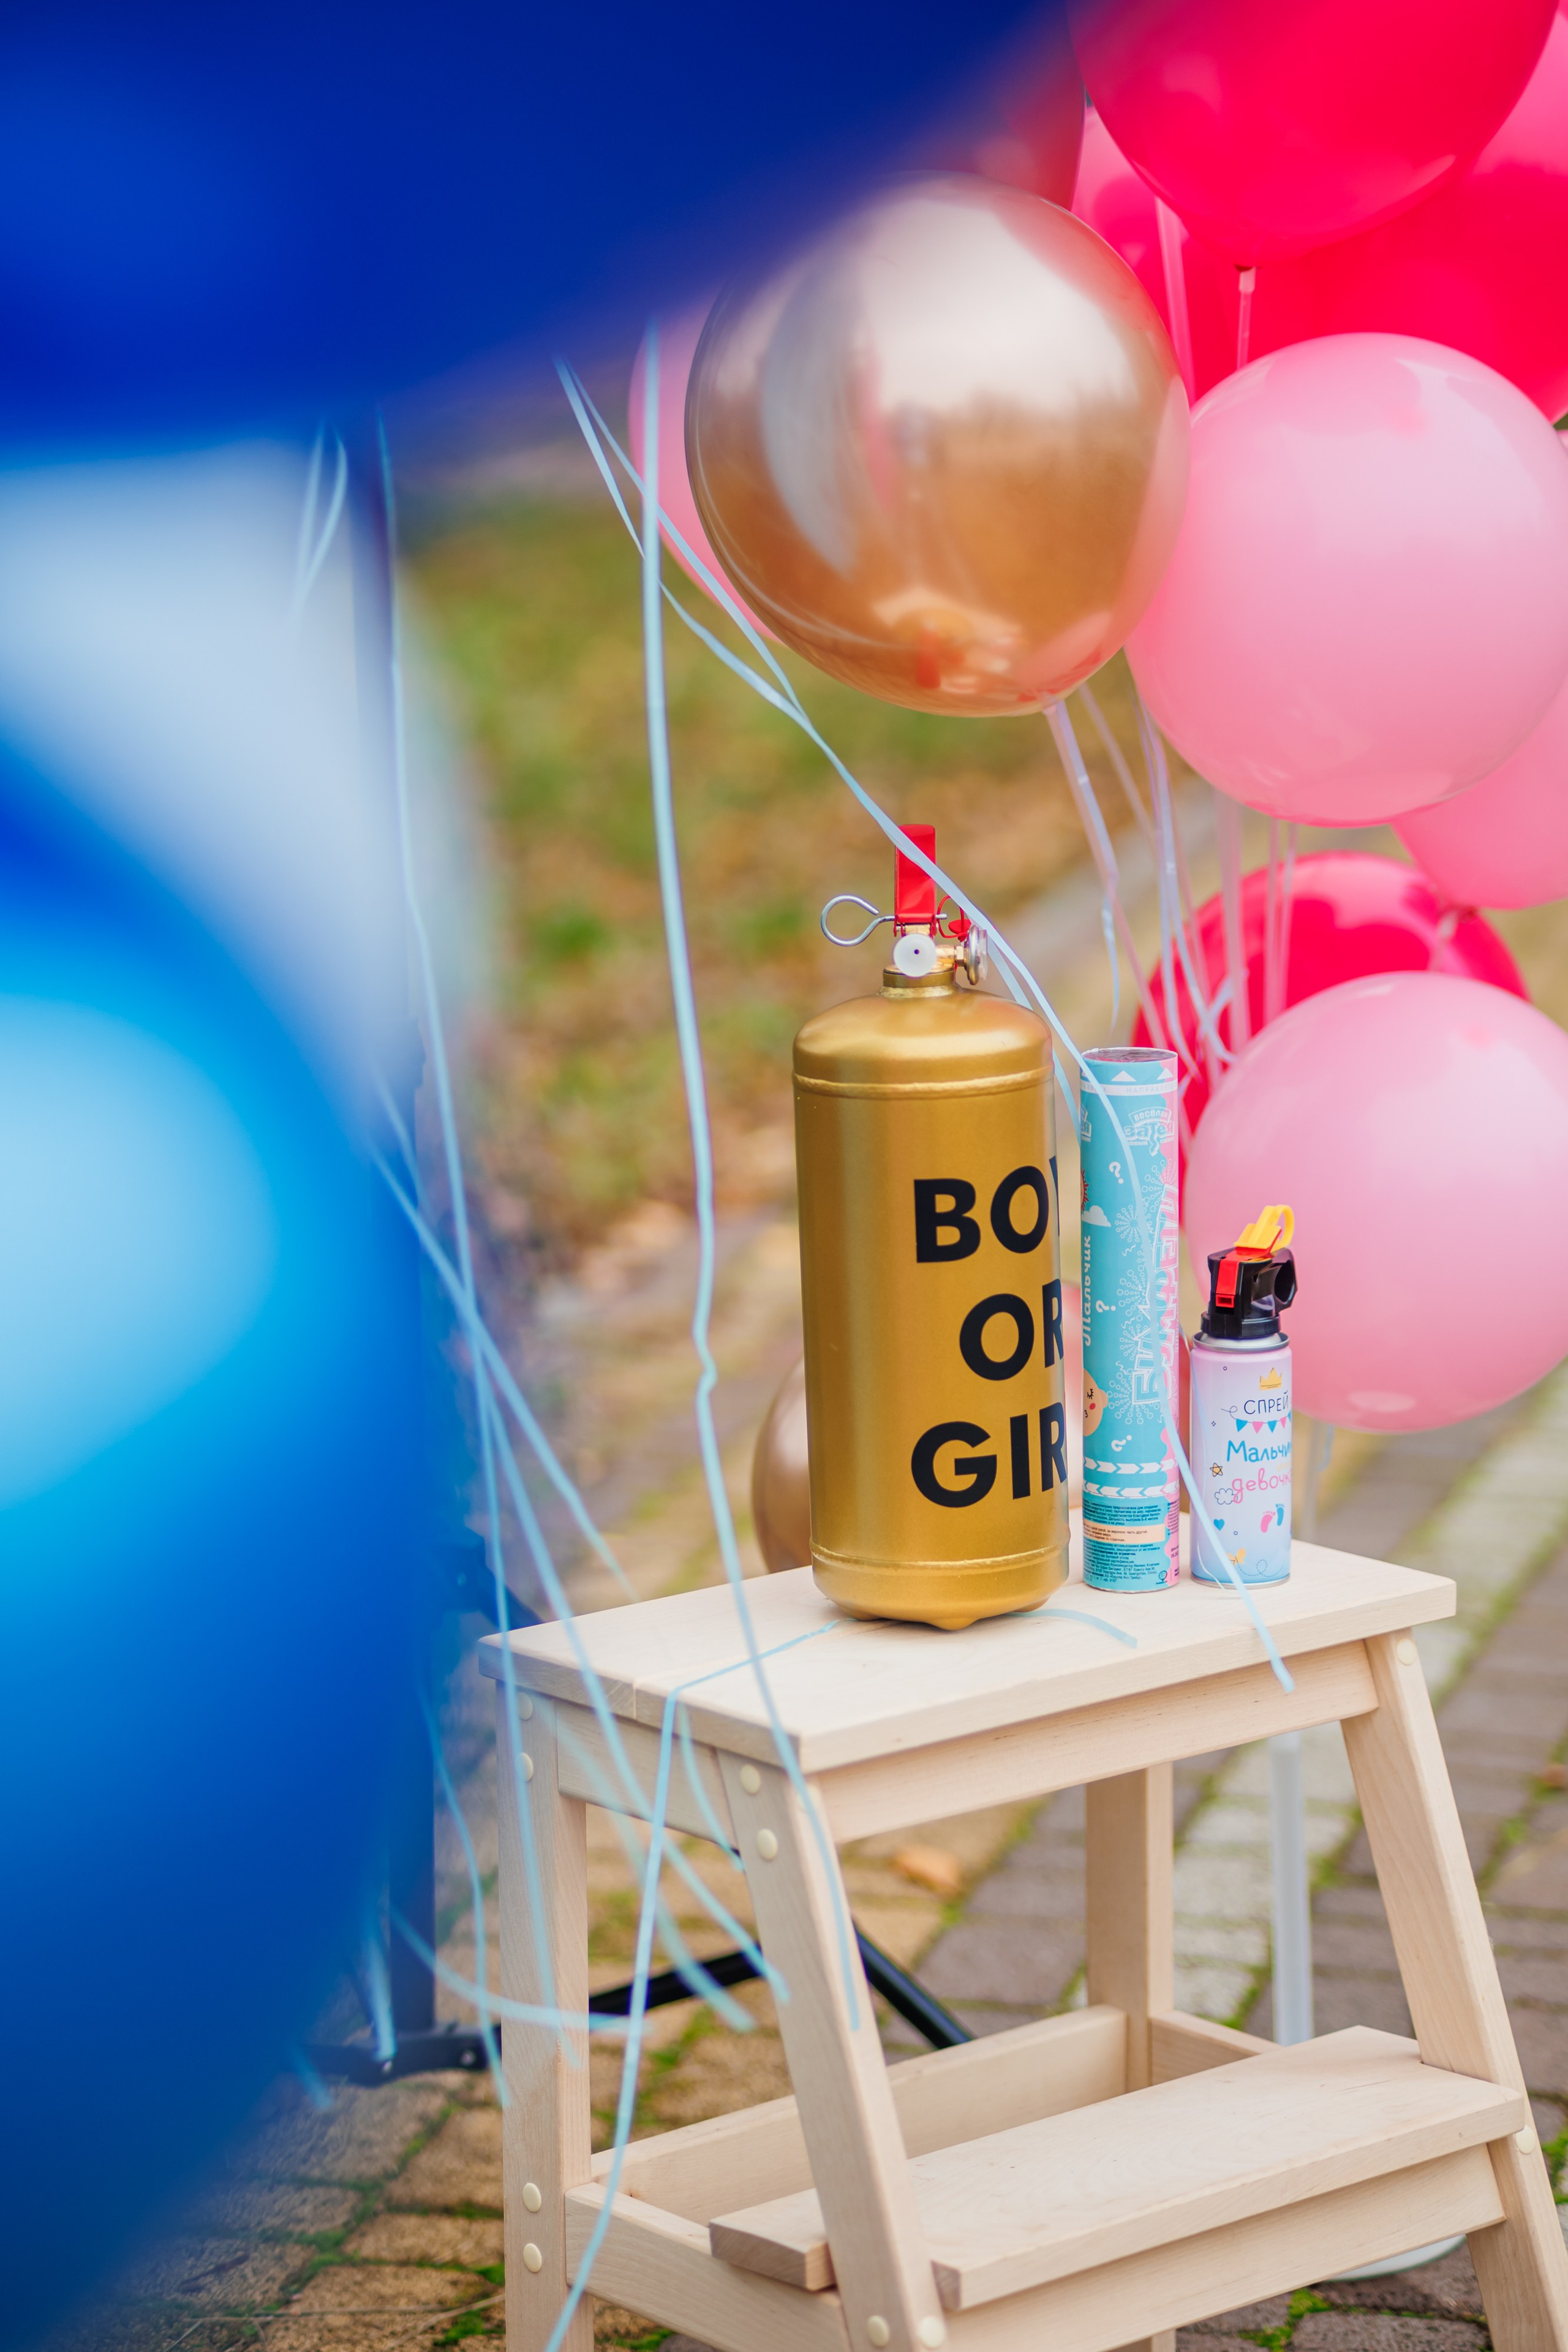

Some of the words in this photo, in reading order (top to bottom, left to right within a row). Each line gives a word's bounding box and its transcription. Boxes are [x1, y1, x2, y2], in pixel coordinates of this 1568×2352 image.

[914, 1155, 1060, 1263] BO
[959, 1278, 1064, 1381] OR
[1082, 1235, 1091, 1346] Мальчик
[1243, 1390, 1289, 1415] СПРЕЙ
